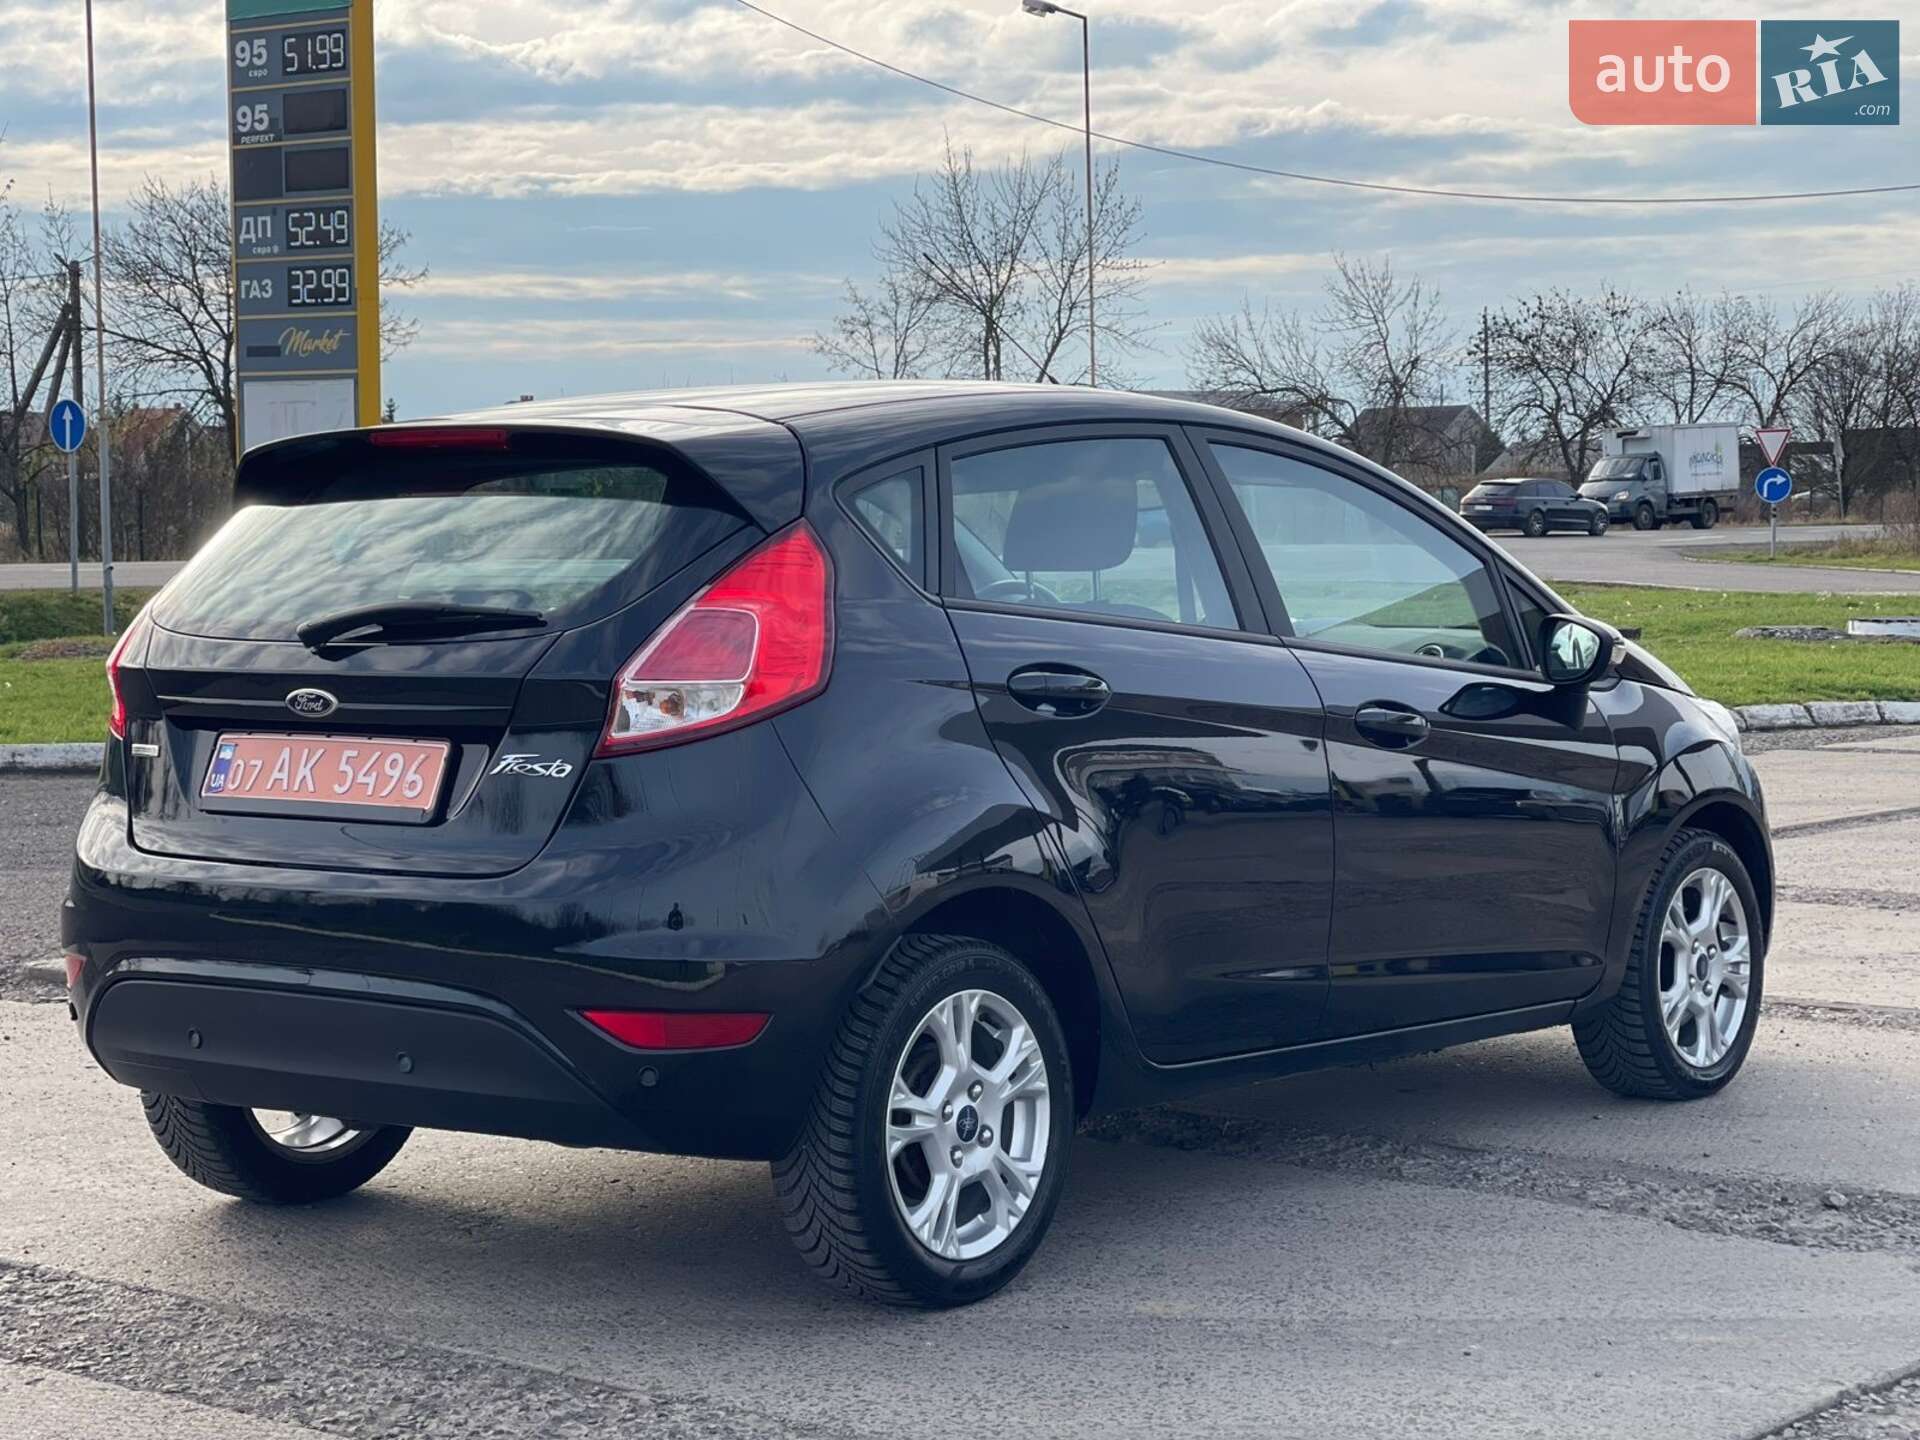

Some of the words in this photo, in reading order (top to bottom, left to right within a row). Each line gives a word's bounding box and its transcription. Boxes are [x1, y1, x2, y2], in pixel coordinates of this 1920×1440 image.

[235, 38, 267, 67] 95
[283, 33, 344, 72] 51.99
[236, 104, 269, 132] 95
[239, 215, 272, 243] ДП
[288, 210, 348, 247] 52.49
[240, 278, 273, 299] ГАЗ
[290, 268, 349, 304] 32.99
[278, 327, 350, 358] Market
[294, 694, 324, 711] Ford
[210, 773, 225, 788] UA
[227, 759, 264, 792] 07
[265, 746, 327, 793] AK
[333, 749, 431, 799] 5496
[489, 753, 573, 778] Fiesta
